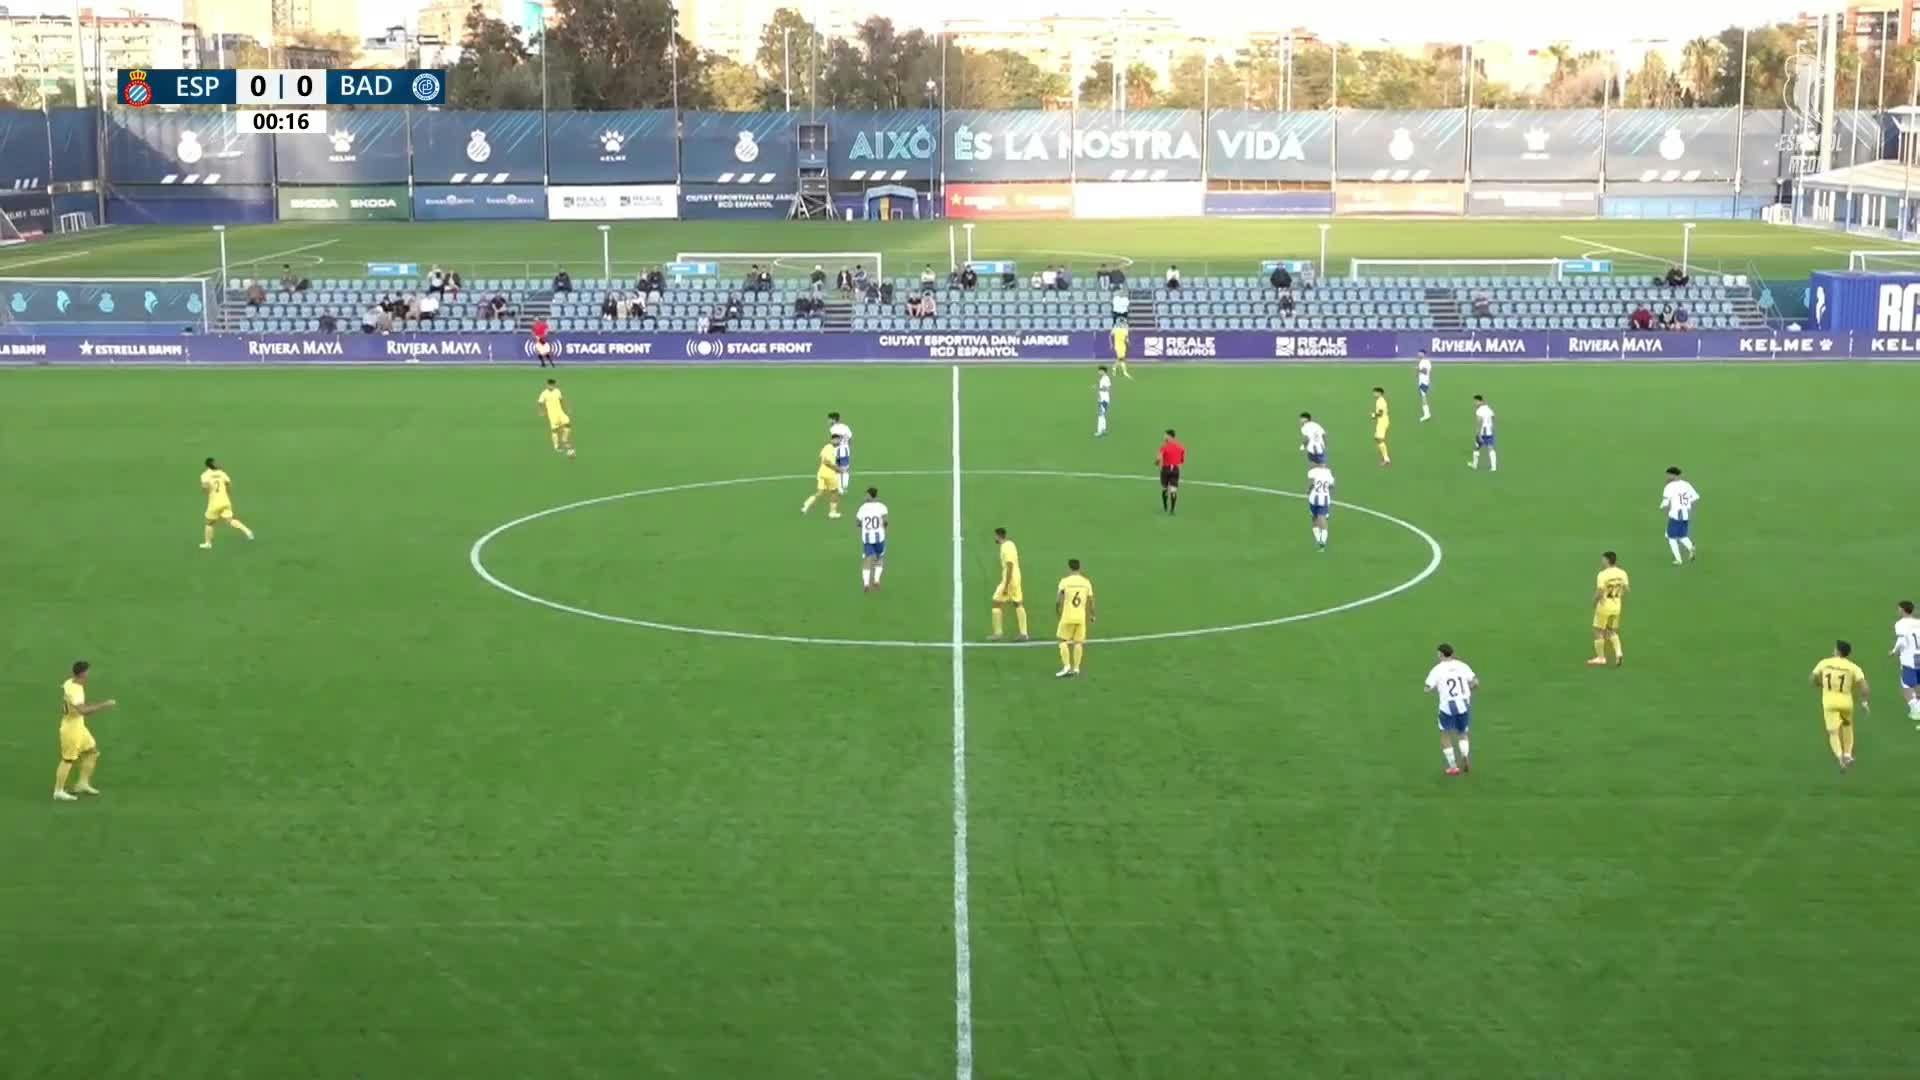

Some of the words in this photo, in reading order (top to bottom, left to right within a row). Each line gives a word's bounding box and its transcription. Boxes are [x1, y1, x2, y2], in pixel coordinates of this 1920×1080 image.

[1005, 130, 1048, 160] LA
[1058, 128, 1200, 160] NOSTRA
[1217, 128, 1306, 160] VIDA
[880, 335, 921, 346] CIUTAT
[924, 335, 988, 346] ESPORTIVA
[1022, 335, 1069, 346] JARQUE
[1166, 337, 1215, 346] REALE
[1297, 337, 1347, 346] REALE
[1431, 338, 1482, 352] RIVIERA
[1485, 338, 1525, 352] MAYA
[1569, 338, 1620, 352] RIVIERA
[1623, 338, 1663, 352] MAYA
[1740, 339, 1814, 351] KELME
[12, 344, 47, 355] DAMM
[95, 345, 147, 355] ESTRELLA
[148, 345, 182, 355] DAMM
[248, 341, 300, 354] RIVIERA
[303, 341, 343, 354] MAYA
[387, 341, 439, 354] RIVIERA
[441, 341, 481, 354] MAYA
[566, 344, 605, 354] STAGE
[608, 343, 652, 354] FRONT
[727, 343, 766, 353] STAGE
[769, 343, 813, 353] FRONT
[930, 347, 955, 356] RCD
[957, 347, 1018, 356] ESPANYOL
[1166, 347, 1216, 356] SEGUROS
[1297, 347, 1348, 356] SEGUROS
[864, 516, 880, 529] 20
[1072, 591, 1081, 608] 6
[1446, 676, 1466, 697] 21
[1825, 673, 1845, 692] 11
